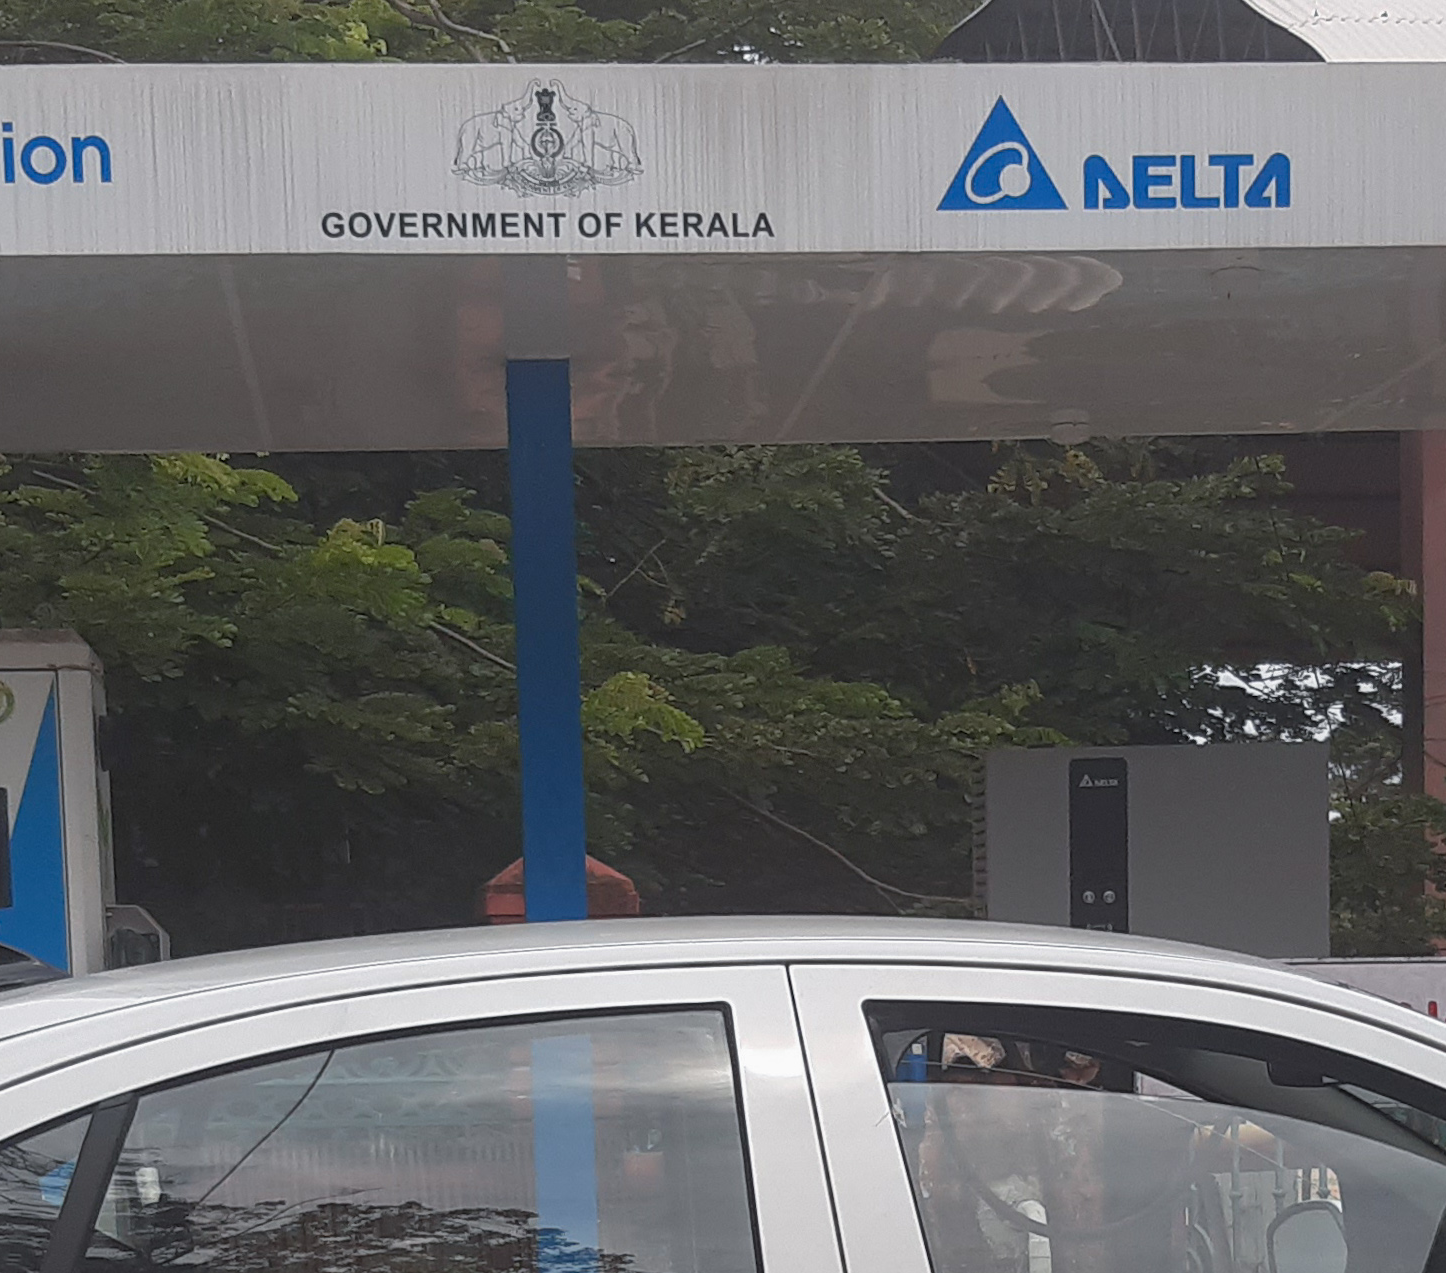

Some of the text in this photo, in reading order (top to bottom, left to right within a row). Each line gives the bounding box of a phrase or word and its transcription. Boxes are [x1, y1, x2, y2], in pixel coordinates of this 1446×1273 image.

[1083, 152, 1292, 209] DELTA
[321, 210, 776, 239] GOVERNMENT OF KERALA
